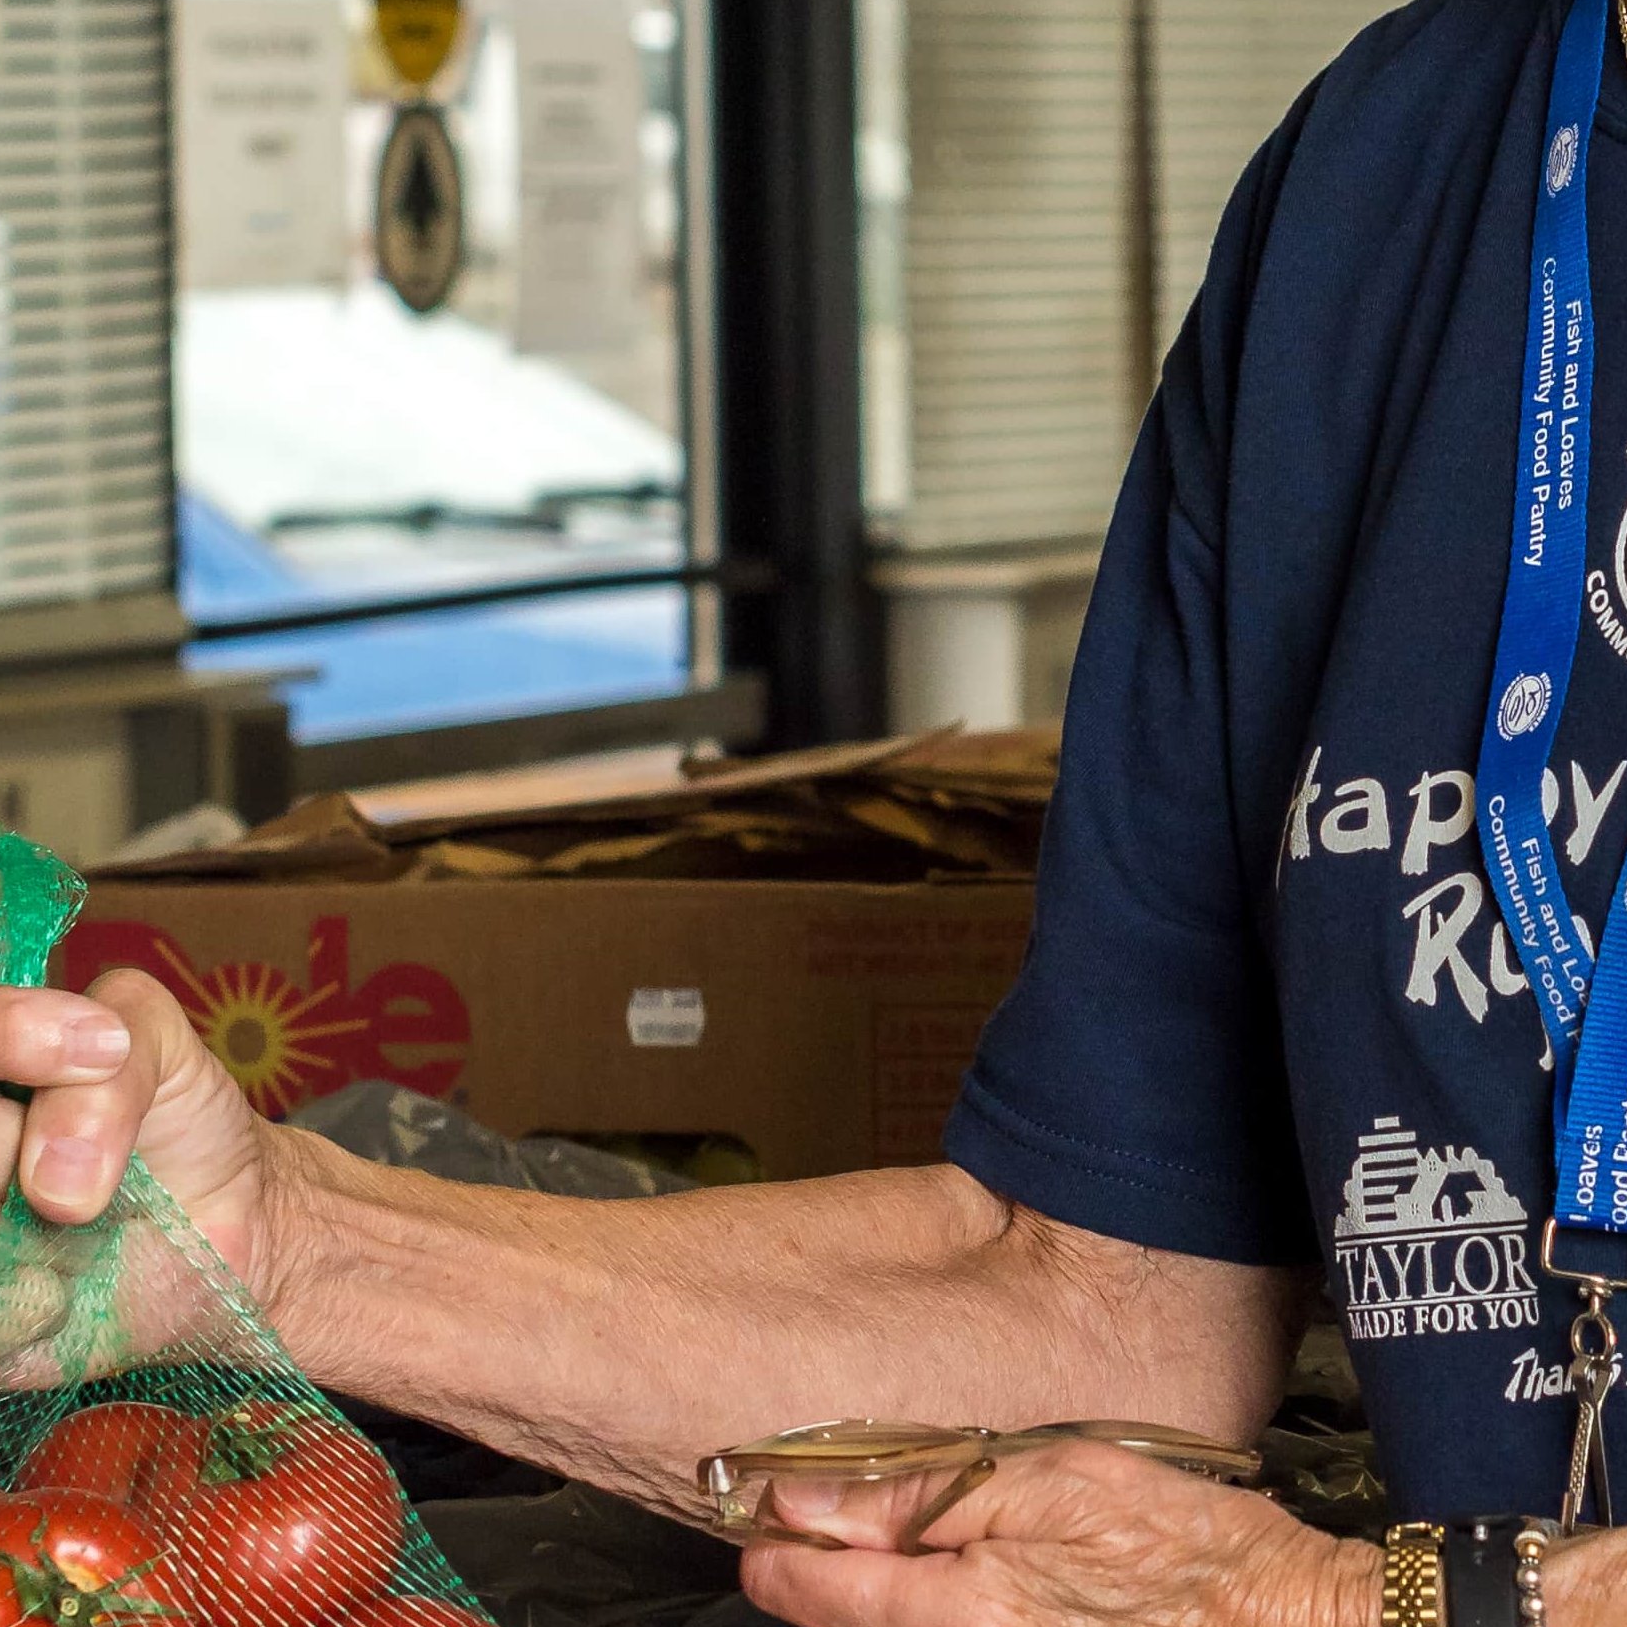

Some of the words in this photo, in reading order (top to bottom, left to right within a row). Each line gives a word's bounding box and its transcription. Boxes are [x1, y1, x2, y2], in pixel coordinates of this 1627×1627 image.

[1532, 256, 1557, 405] Community
[1565, 299, 1583, 357] Fish
[1561, 361, 1581, 412] and
[1531, 409, 1554, 480] Food
[1557, 416, 1580, 512] Loaves
[1523, 484, 1552, 568] Pantry
[1487, 794, 1540, 950] Community
[1534, 954, 1577, 1029] Food
[1521, 837, 1548, 898] Fish
[1538, 903, 1571, 956] and
[1336, 1234, 1538, 1305] TAYLOR
[1347, 1308, 1407, 1340] MADE
[1414, 1303, 1478, 1335] FOR
[1482, 1297, 1540, 1330] YOU
